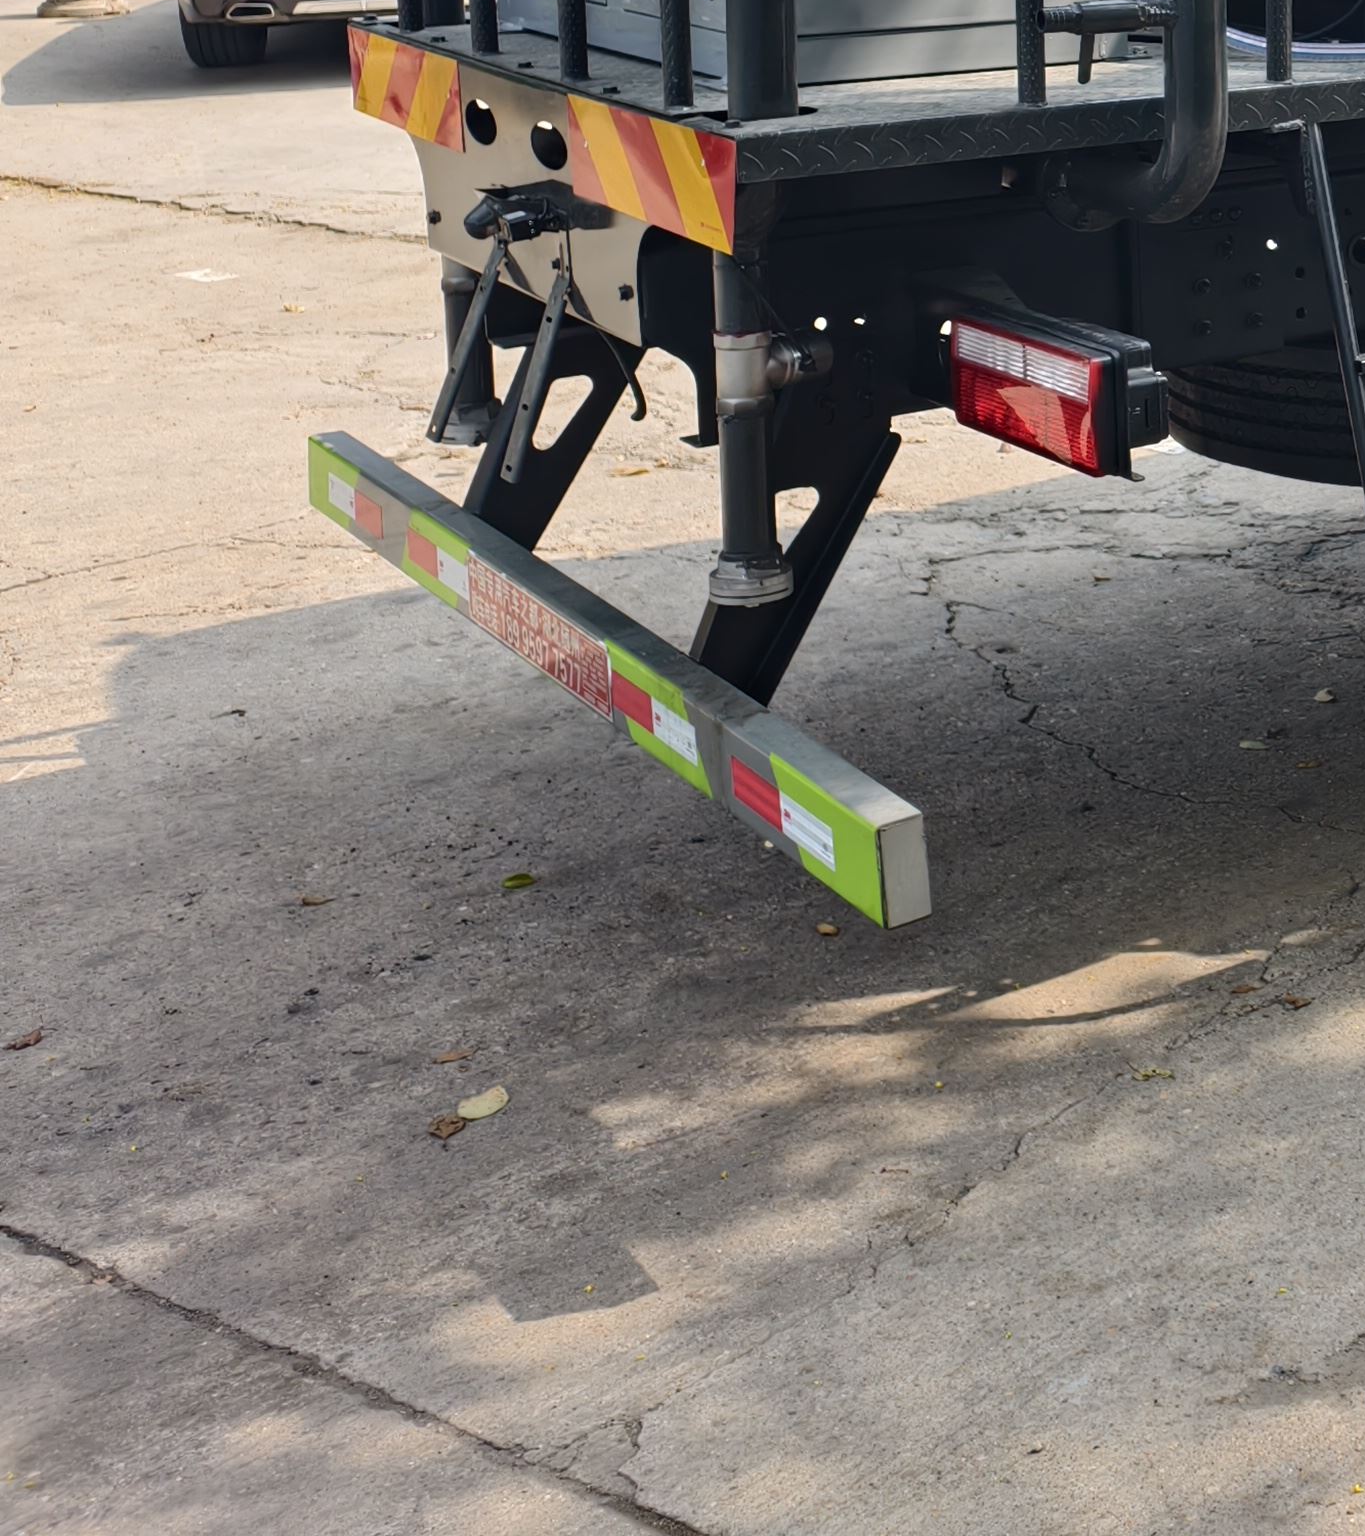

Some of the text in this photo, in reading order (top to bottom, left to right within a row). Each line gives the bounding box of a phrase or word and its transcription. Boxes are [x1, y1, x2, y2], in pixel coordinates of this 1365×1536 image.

[501, 611, 520, 649] 189
[521, 626, 549, 671] 9597
[551, 646, 581, 694] 7577
